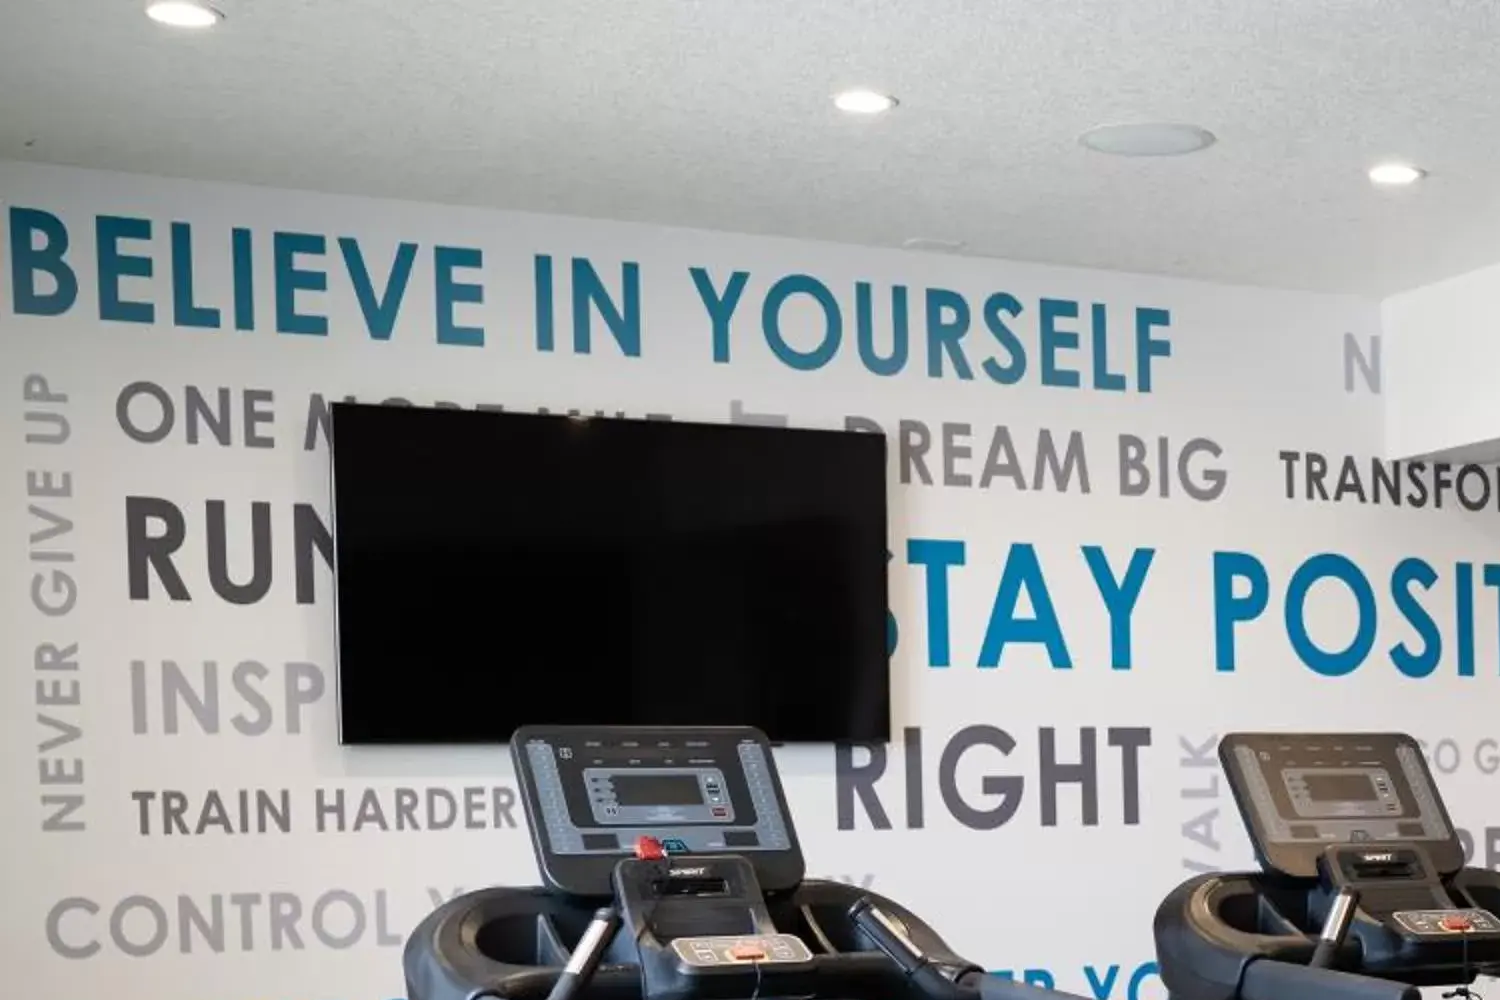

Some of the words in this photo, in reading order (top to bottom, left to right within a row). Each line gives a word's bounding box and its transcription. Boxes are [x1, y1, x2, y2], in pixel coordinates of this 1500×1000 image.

[9, 206, 485, 347] BELIEVE
[534, 254, 641, 357] IN
[688, 266, 1171, 393] YOURSELF
[23, 373, 72, 444] UP
[116, 380, 275, 449] ONE
[1119, 433, 1228, 501] BIG
[29, 469, 78, 617] GIVE
[888, 538, 1157, 670] TAY
[34, 641, 87, 832] NEVER
[834, 724, 1152, 831] RIGHT
[131, 788, 291, 836] TRAIN
[314, 786, 518, 833] HARDER
[45, 889, 403, 960] CONTROL
